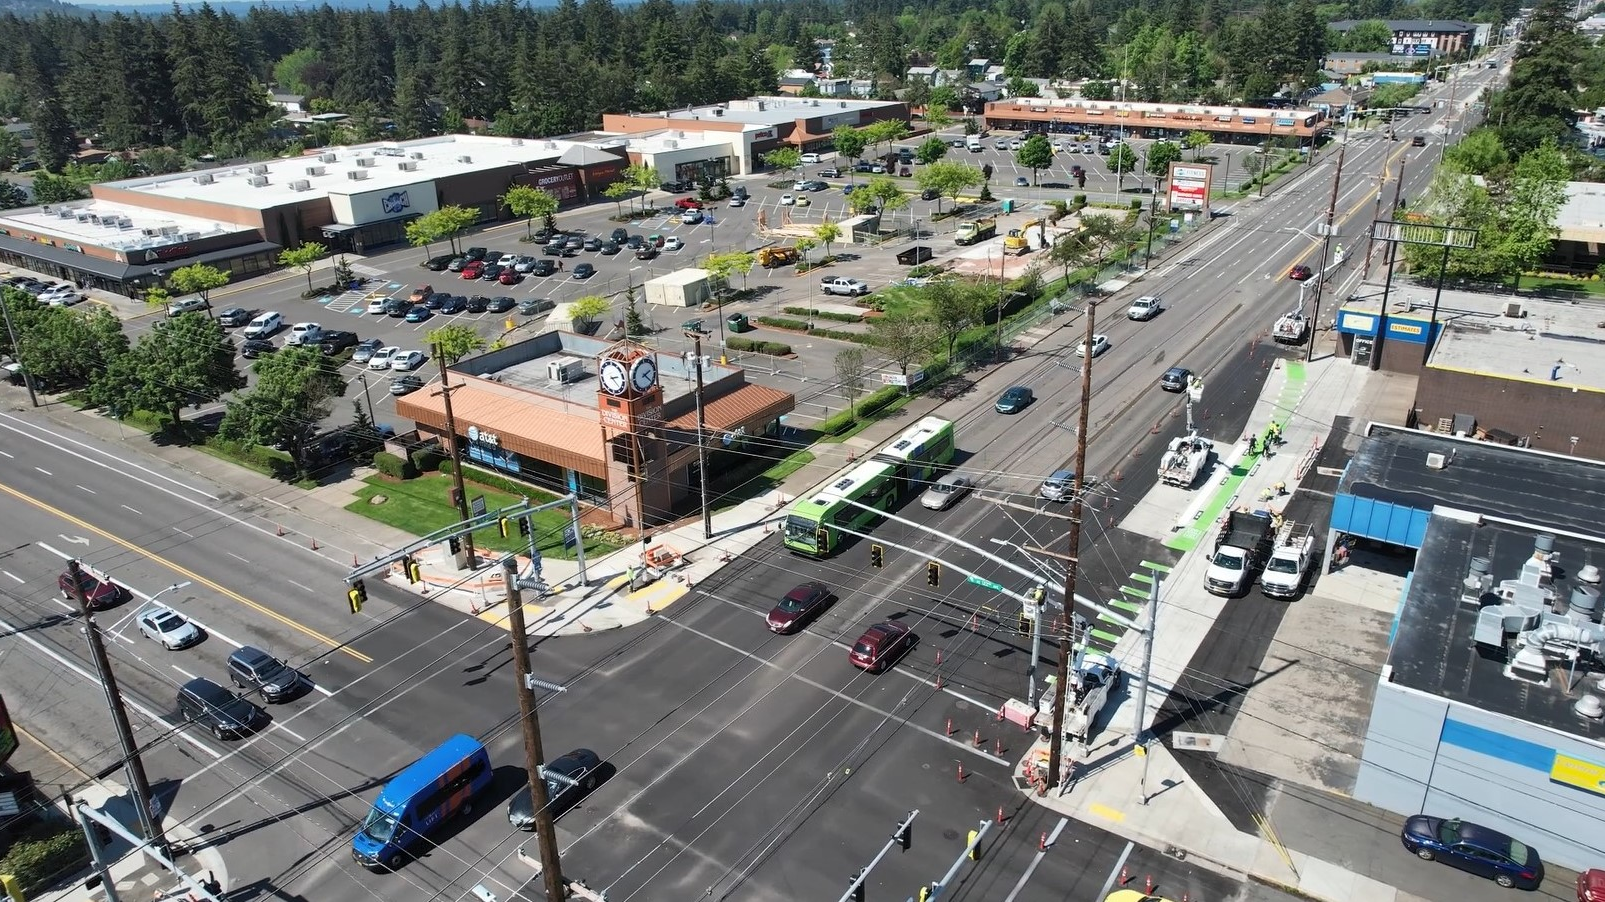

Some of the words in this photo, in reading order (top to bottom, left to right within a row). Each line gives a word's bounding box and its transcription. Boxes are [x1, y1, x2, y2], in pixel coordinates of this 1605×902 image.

[1391, 324, 1420, 334] ESTIMATES
[601, 410, 629, 421] DIVISION
[637, 405, 662, 420] DIVISION
[603, 416, 628, 429] CENTER
[479, 431, 499, 446] at&t
